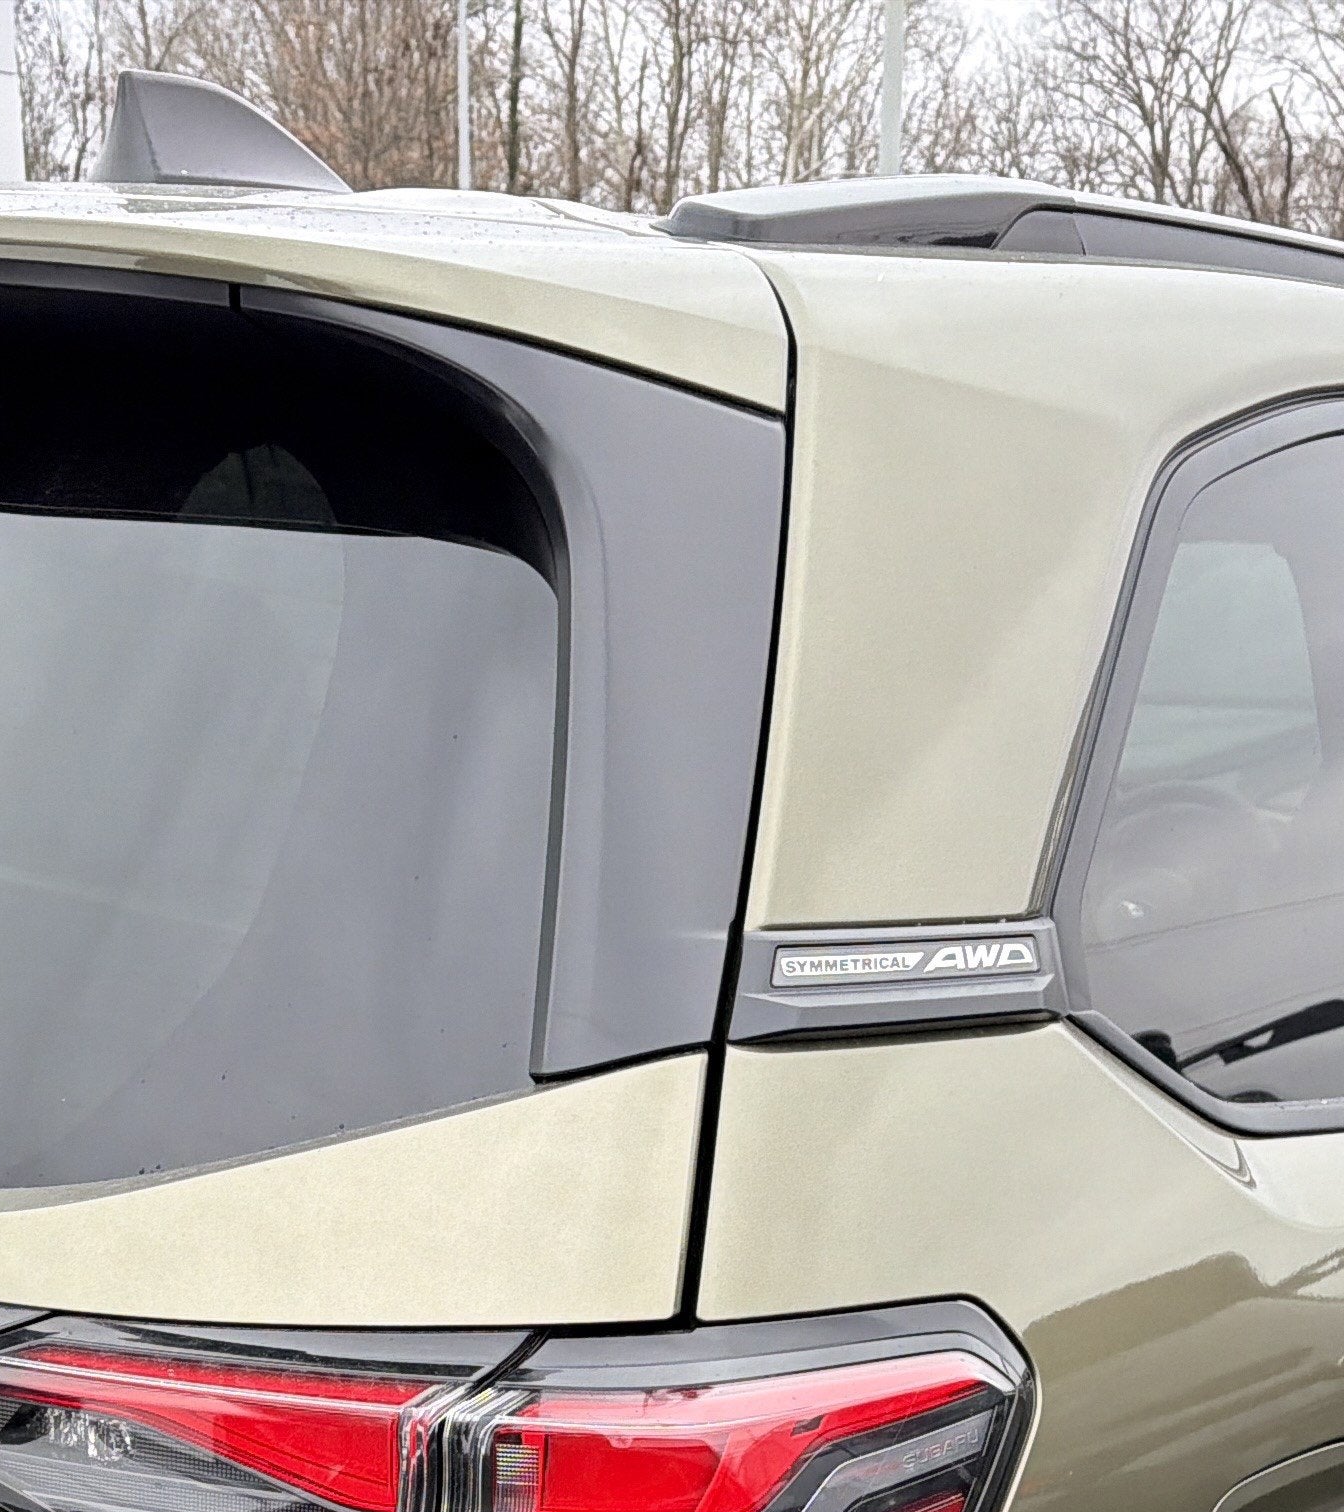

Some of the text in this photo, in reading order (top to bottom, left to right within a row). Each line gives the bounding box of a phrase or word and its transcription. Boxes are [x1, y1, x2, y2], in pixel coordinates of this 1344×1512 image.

[784, 942, 1035, 975] SYMMETRICAL AWD
[902, 1428, 979, 1468] SUBARU
